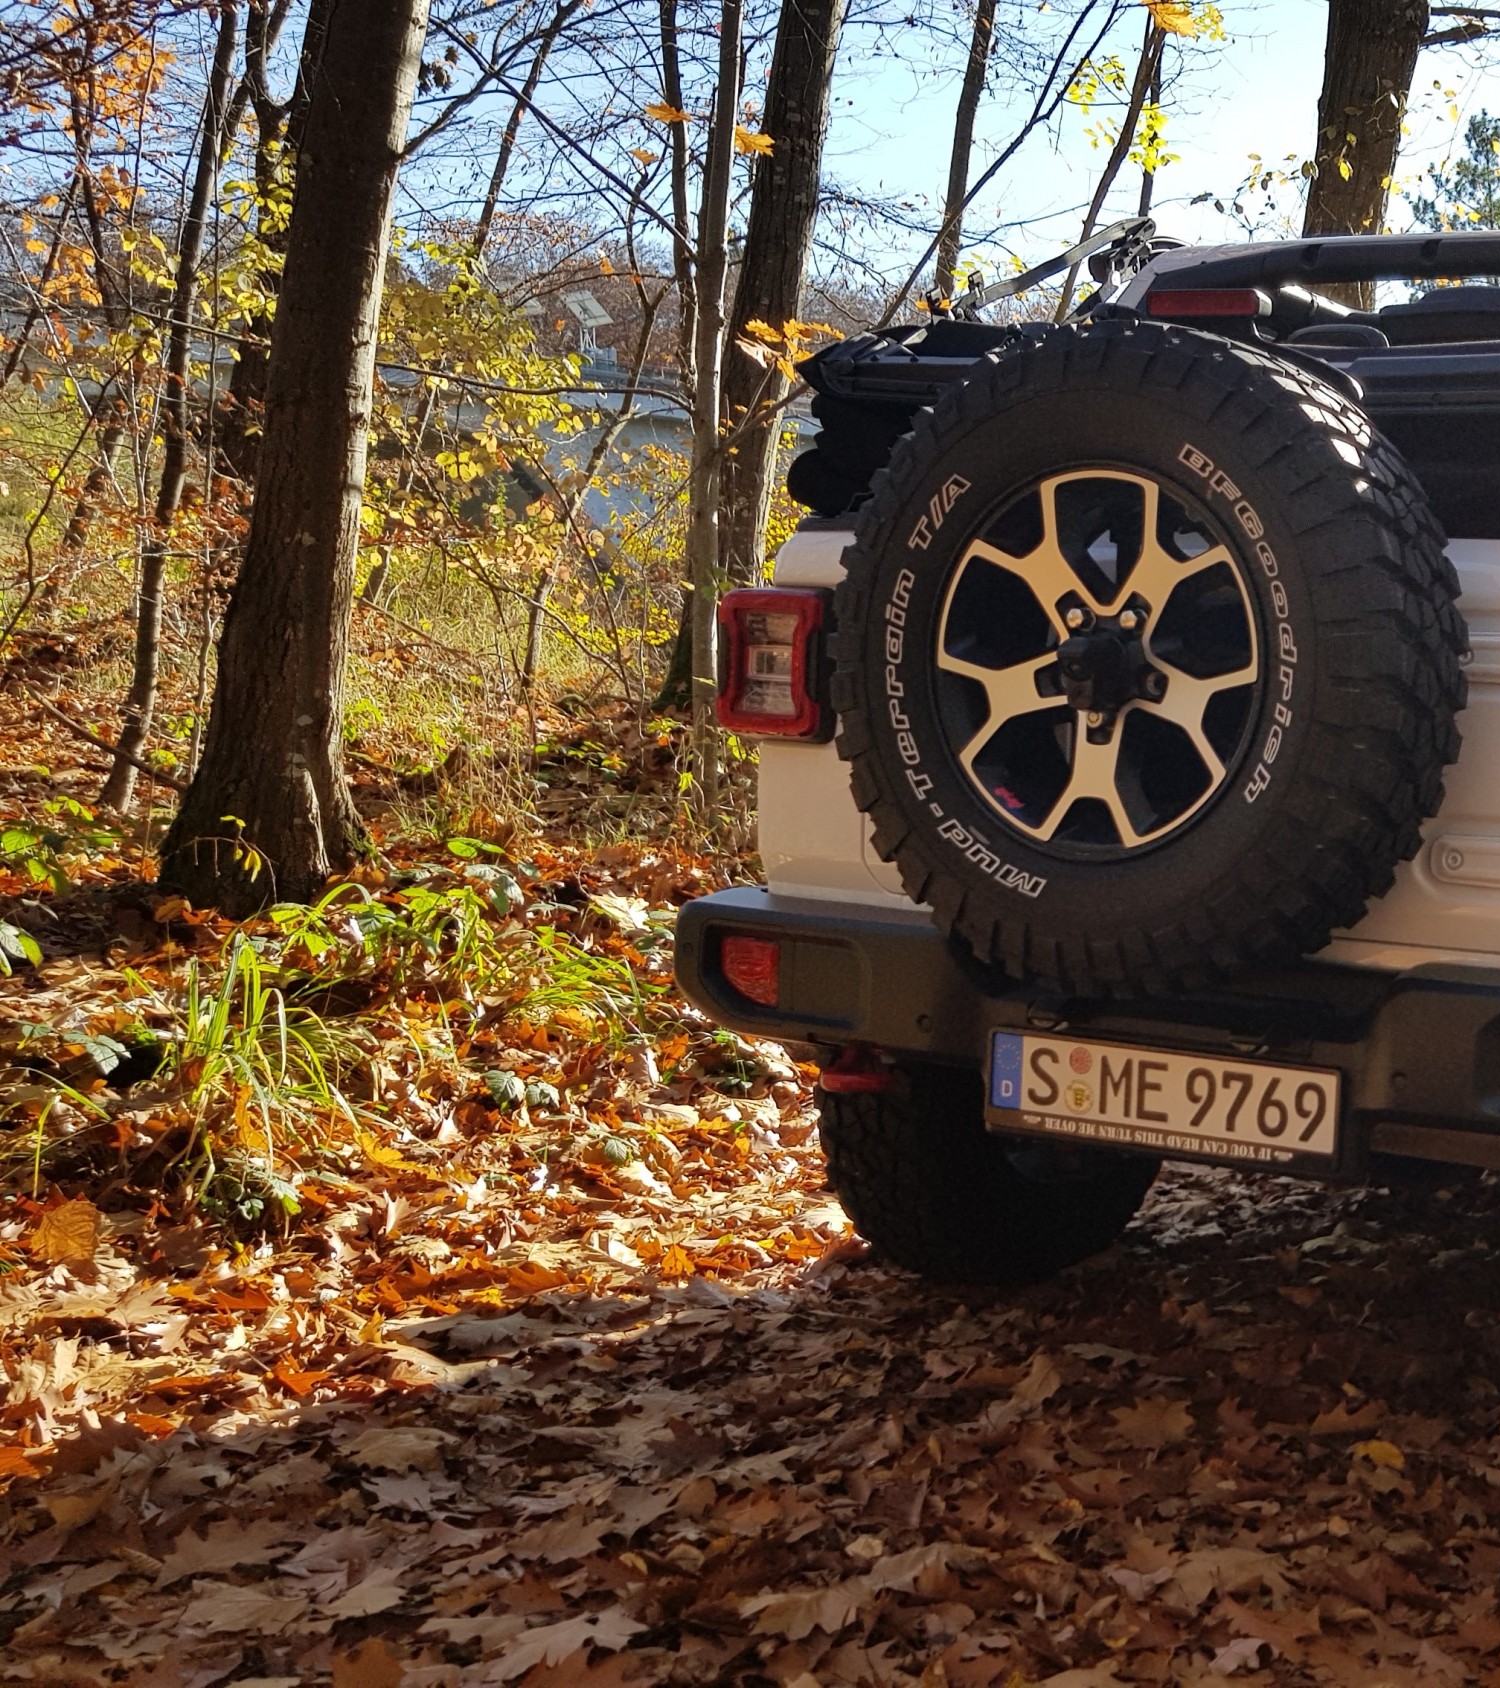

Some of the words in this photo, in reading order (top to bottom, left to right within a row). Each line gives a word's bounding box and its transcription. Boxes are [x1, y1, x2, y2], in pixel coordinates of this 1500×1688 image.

[908, 473, 972, 551] T/A
[1178, 443, 1298, 804] BFGoodrich
[1001, 1079, 1013, 1097] D
[1027, 1047, 1060, 1106] S
[1098, 1054, 1169, 1123] ME
[1185, 1067, 1327, 1143] 9769
[1045, 1116, 1077, 1133] OVER
[1078, 1121, 1097, 1136] ME
[1098, 1124, 1133, 1142] TURN
[1134, 1129, 1165, 1146] THIS
[1166, 1134, 1200, 1152] READ
[1202, 1139, 1228, 1155] CAN
[1230, 1143, 1256, 1160] YOU
[1258, 1146, 1272, 1161] IF
